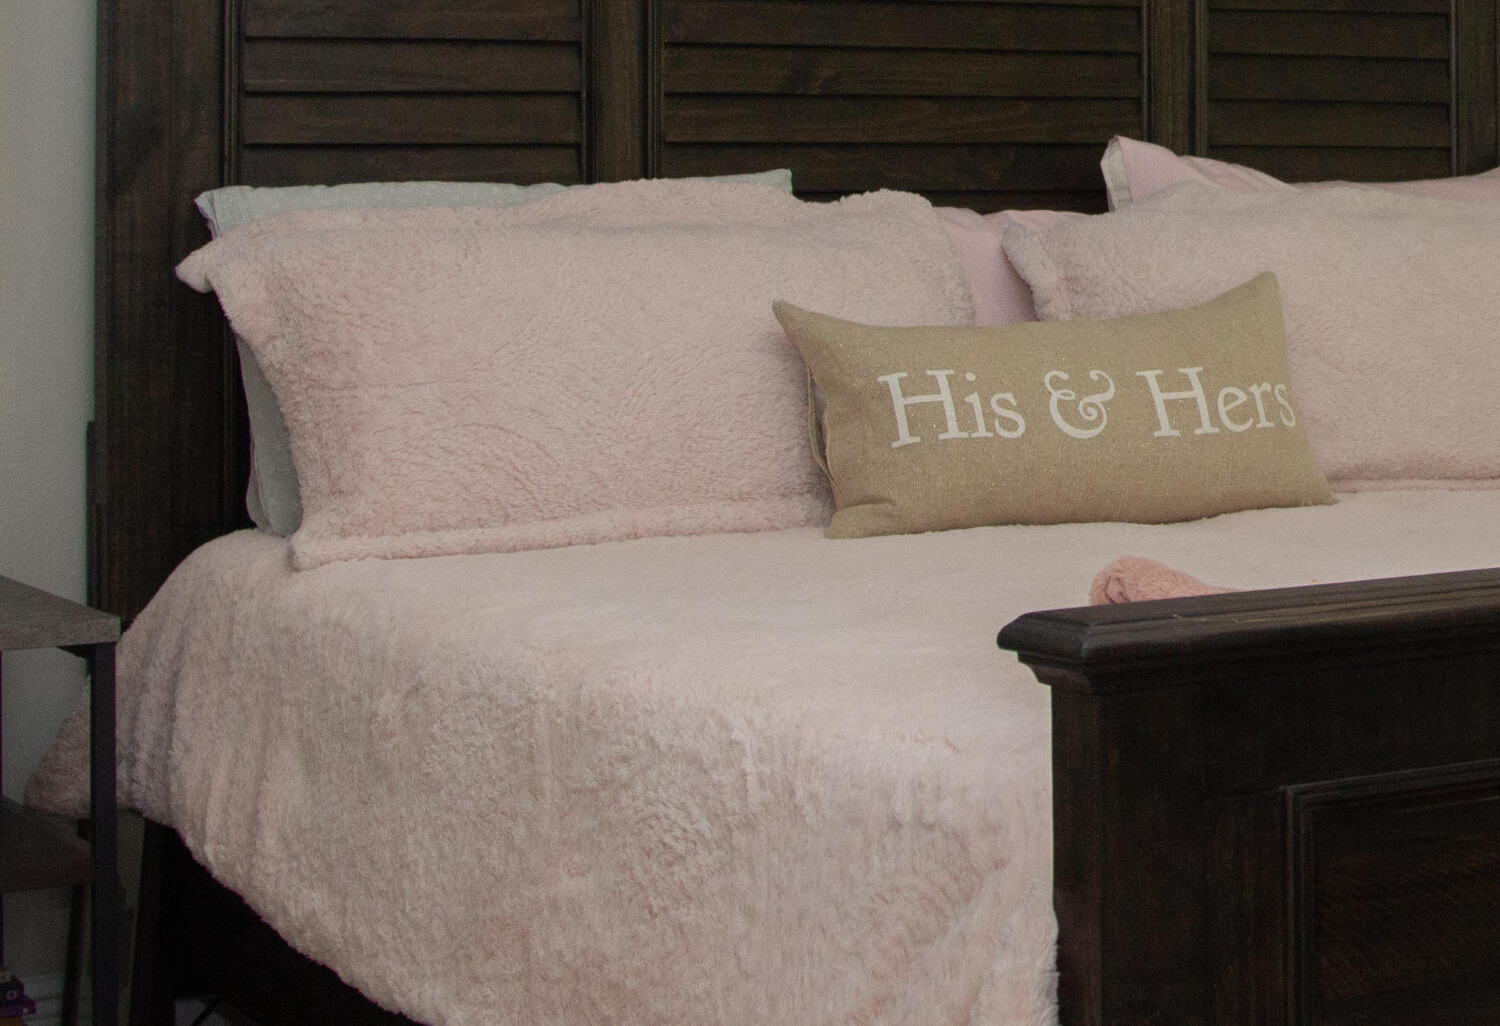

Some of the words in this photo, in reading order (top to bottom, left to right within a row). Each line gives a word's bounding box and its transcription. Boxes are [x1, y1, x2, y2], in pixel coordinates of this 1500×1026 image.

[877, 369, 1027, 449] His
[1044, 370, 1116, 440] &
[1136, 366, 1297, 439] Hers
